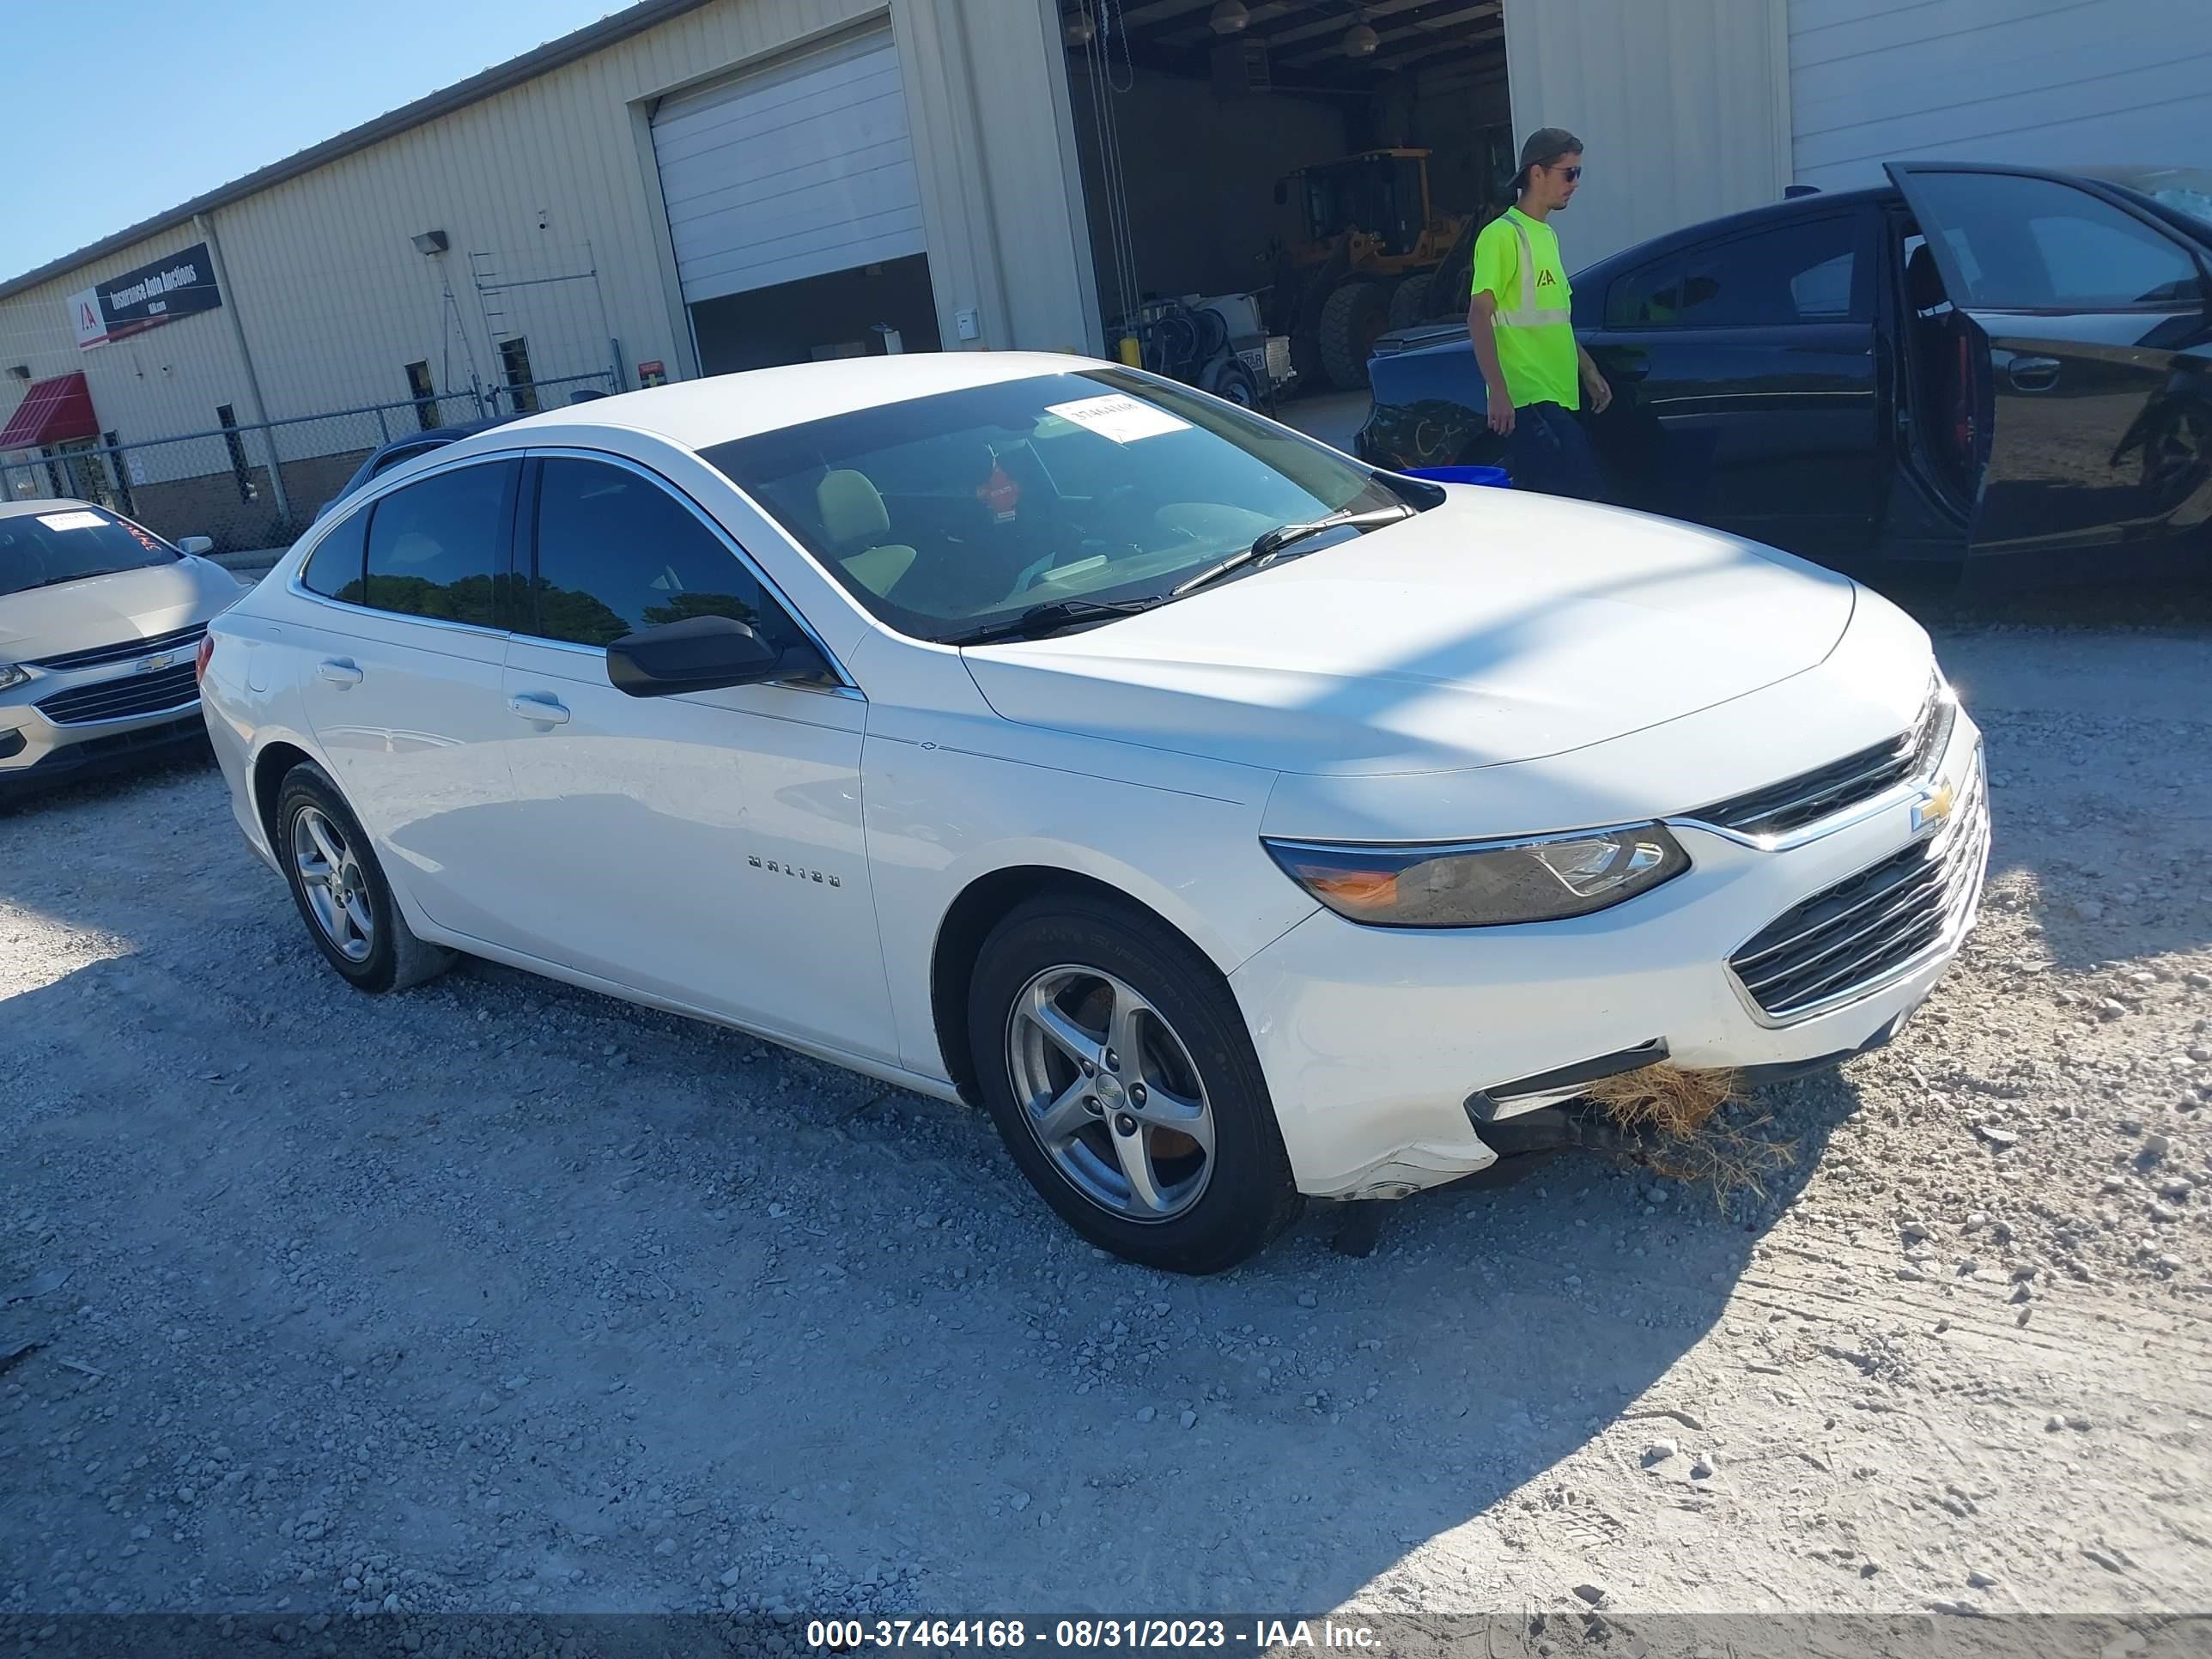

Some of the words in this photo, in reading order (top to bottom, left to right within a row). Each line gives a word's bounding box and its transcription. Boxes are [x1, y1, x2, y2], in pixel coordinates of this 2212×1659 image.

[110, 283, 147, 310] Insurance
[144, 276, 163, 298] Auto
[161, 264, 197, 291] Auctions
[748, 855, 841, 888] MALIBU
